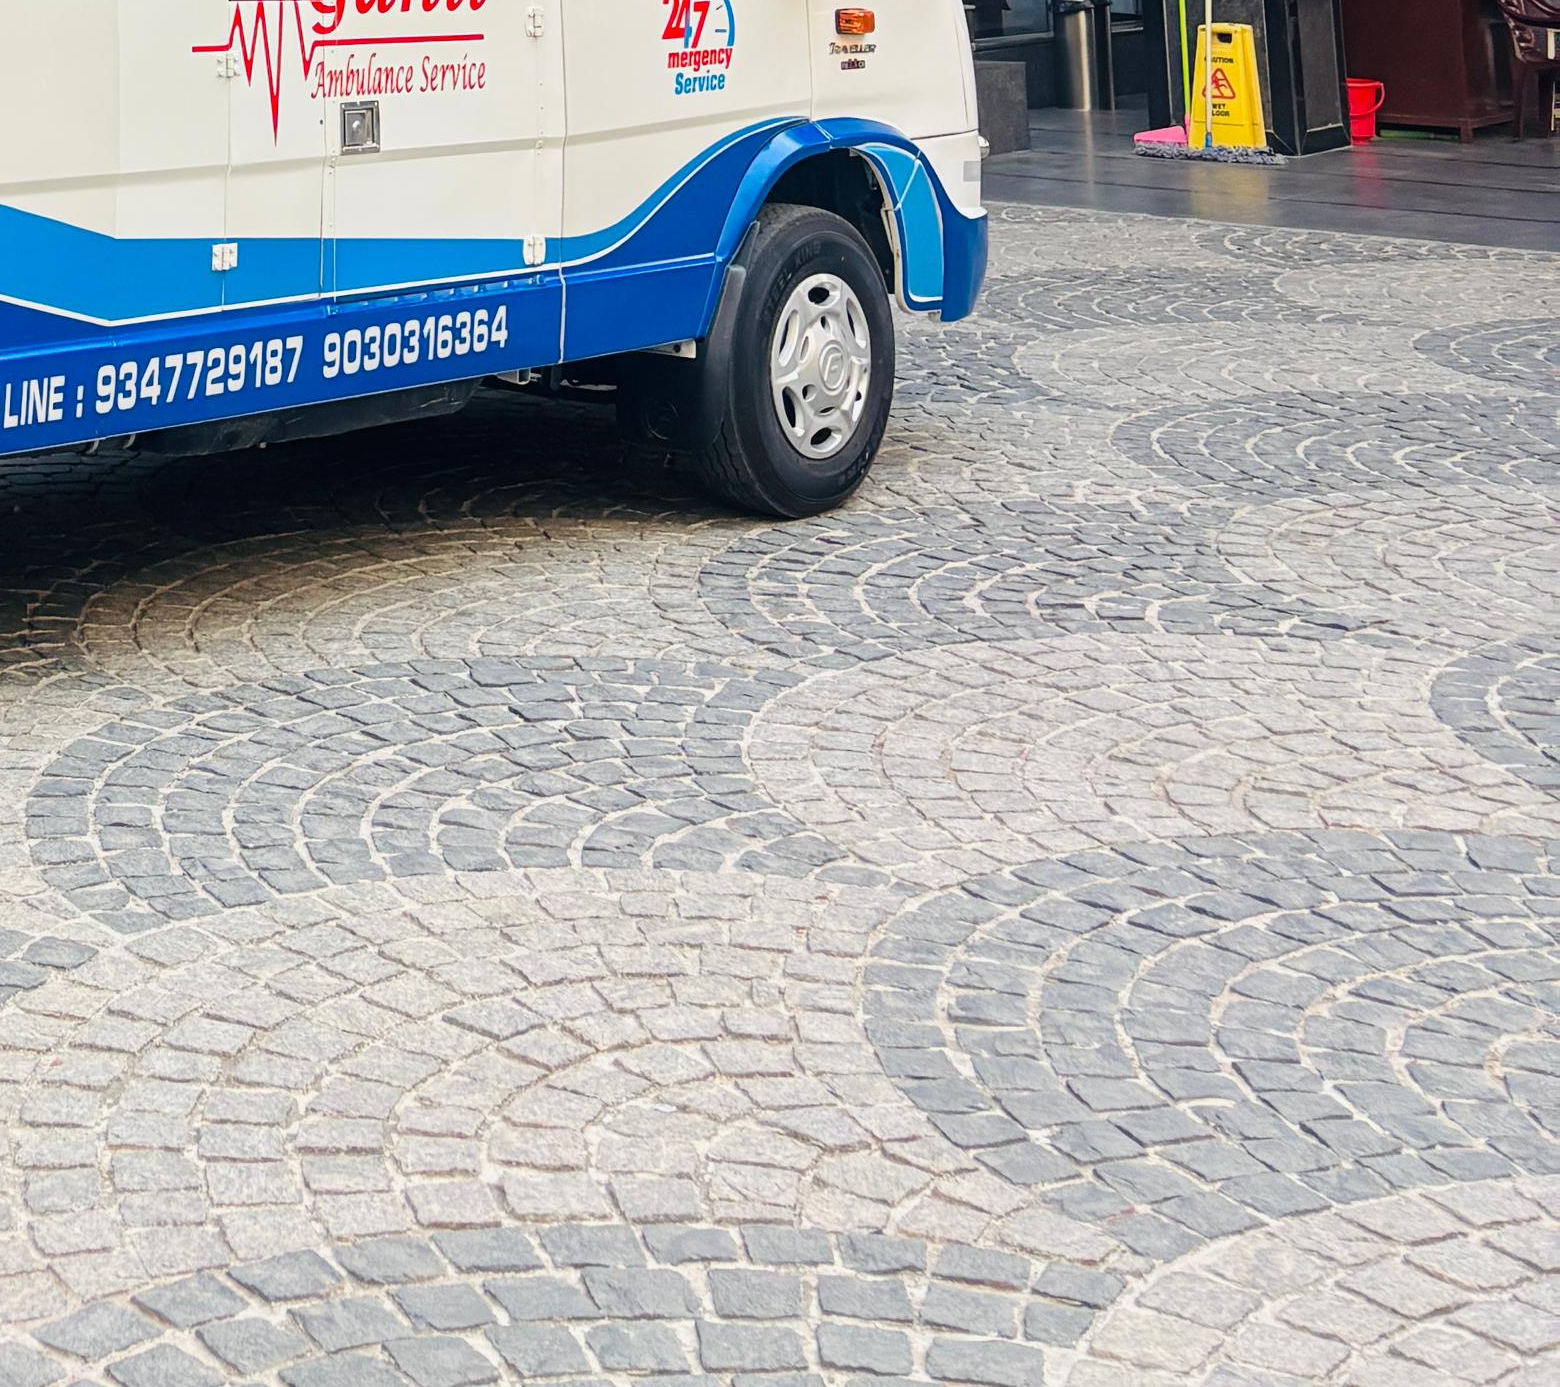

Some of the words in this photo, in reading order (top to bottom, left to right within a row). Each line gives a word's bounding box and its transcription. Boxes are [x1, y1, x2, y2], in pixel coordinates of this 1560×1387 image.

[310, 52, 414, 100] Ambulance
[420, 53, 486, 93] Service
[674, 69, 725, 95] Service
[3, 374, 65, 430] LINE
[95, 335, 303, 415] 9347729187
[323, 305, 508, 378] 9030316364
